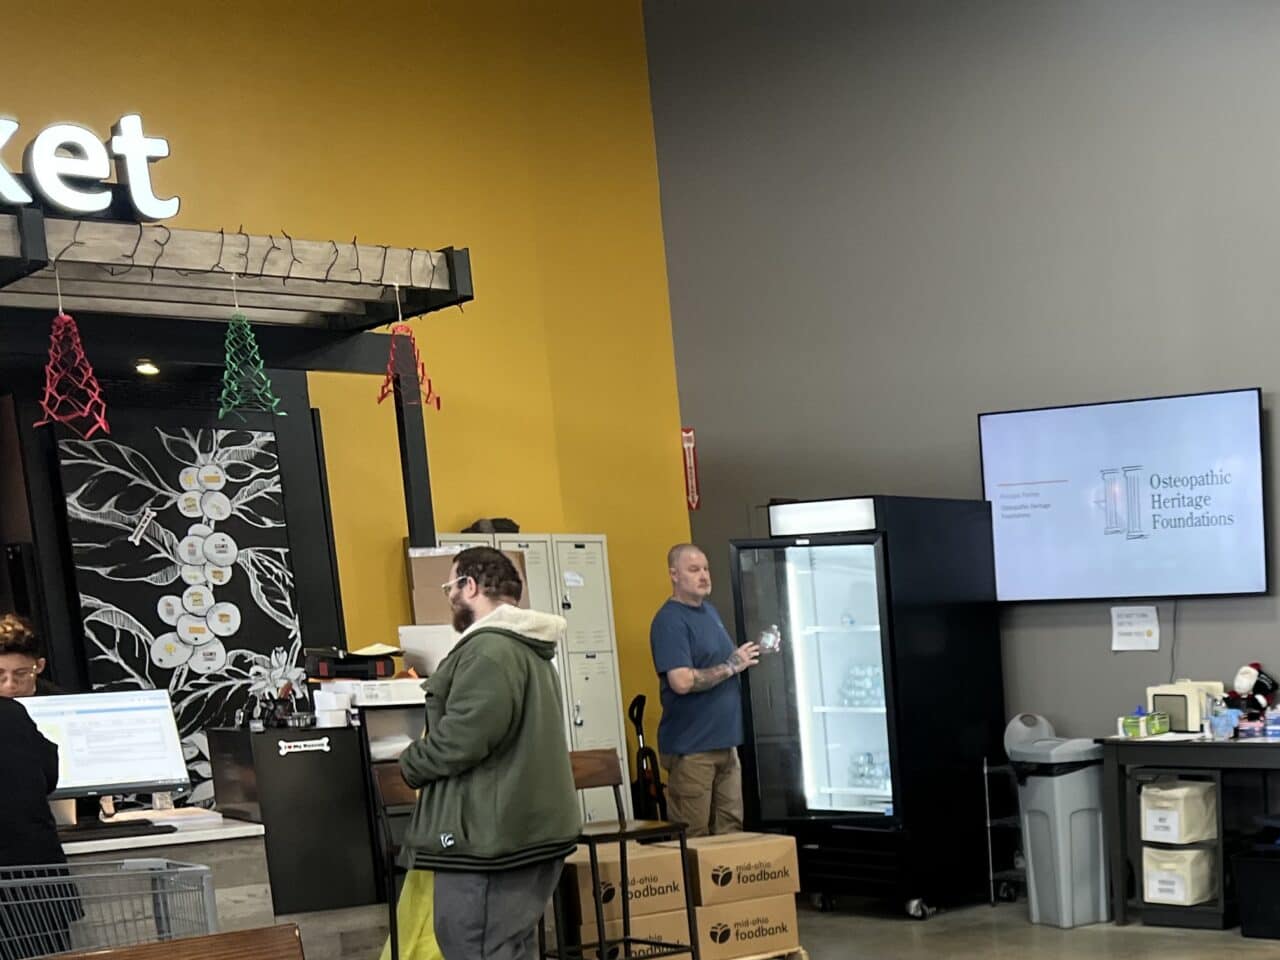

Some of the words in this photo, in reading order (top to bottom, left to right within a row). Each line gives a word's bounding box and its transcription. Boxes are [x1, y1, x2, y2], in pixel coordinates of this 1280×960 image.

[1150, 469, 1232, 490] Osteopathic
[1151, 492, 1212, 510] Heritage
[1152, 511, 1235, 529] Foundations
[736, 862, 772, 872] mid-ohio
[737, 865, 790, 885] foodbank
[626, 880, 680, 900] oodbank
[734, 917, 769, 928] mid-ohio
[735, 921, 788, 942] foodbank
